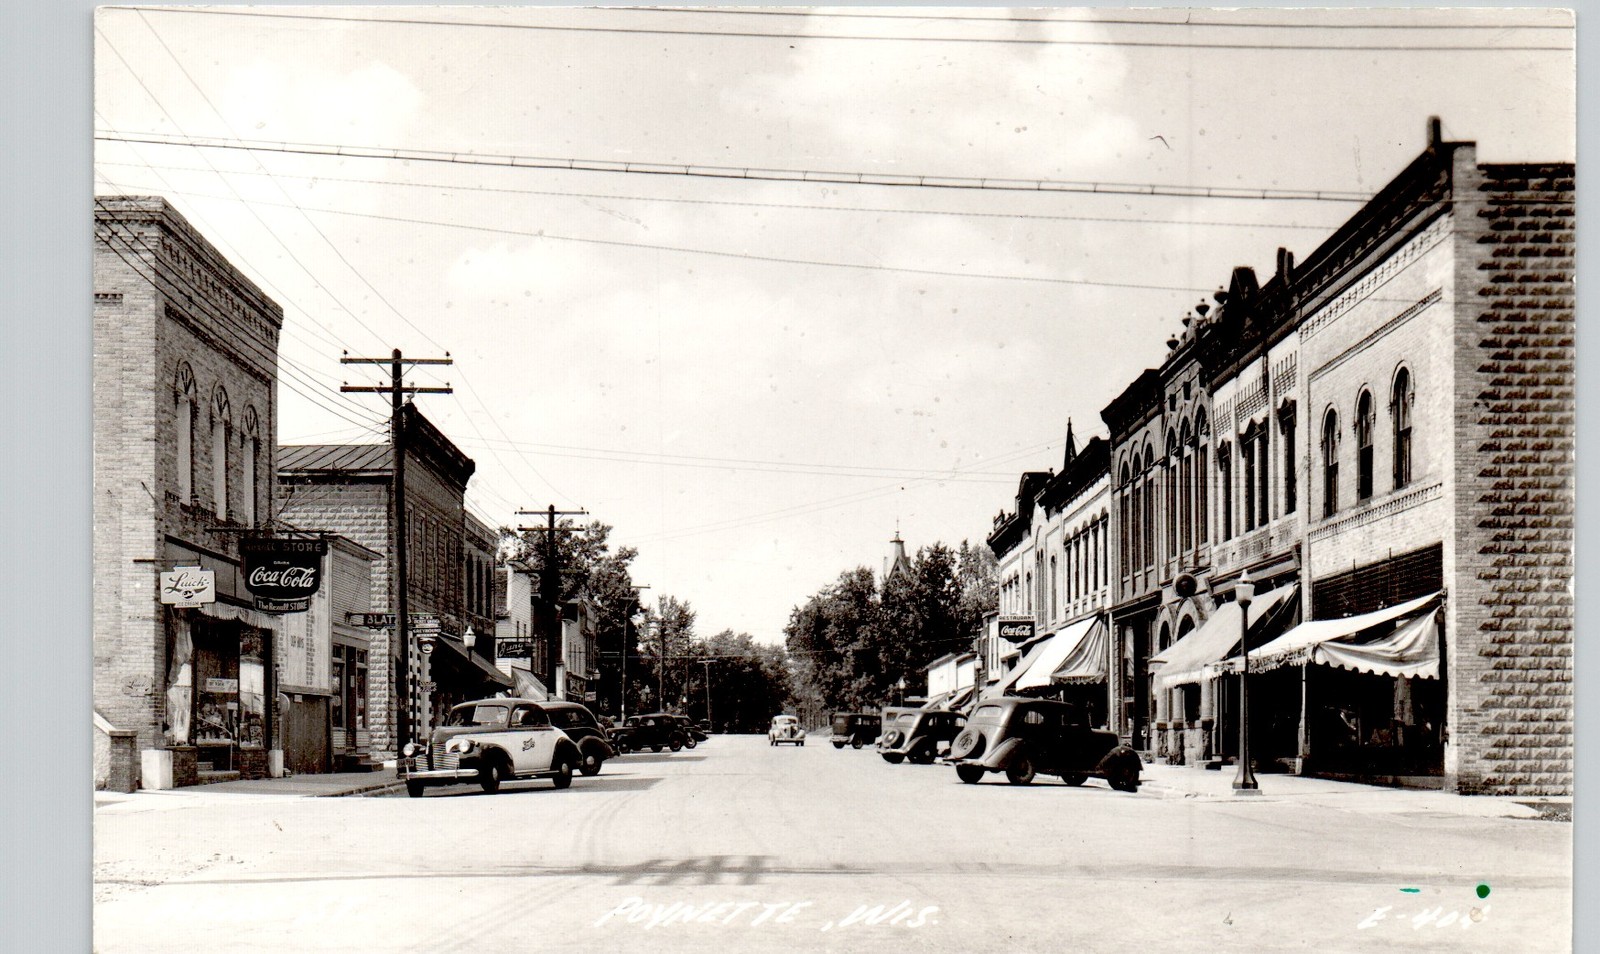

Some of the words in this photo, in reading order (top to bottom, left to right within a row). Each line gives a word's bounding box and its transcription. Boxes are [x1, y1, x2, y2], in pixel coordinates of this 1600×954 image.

[282, 542, 322, 552] STORE
[249, 566, 316, 588] Coca-Cola
[257, 600, 269, 610] The
[290, 601, 308, 611] STORE
[1000, 624, 1032, 637] Coca-Cola
